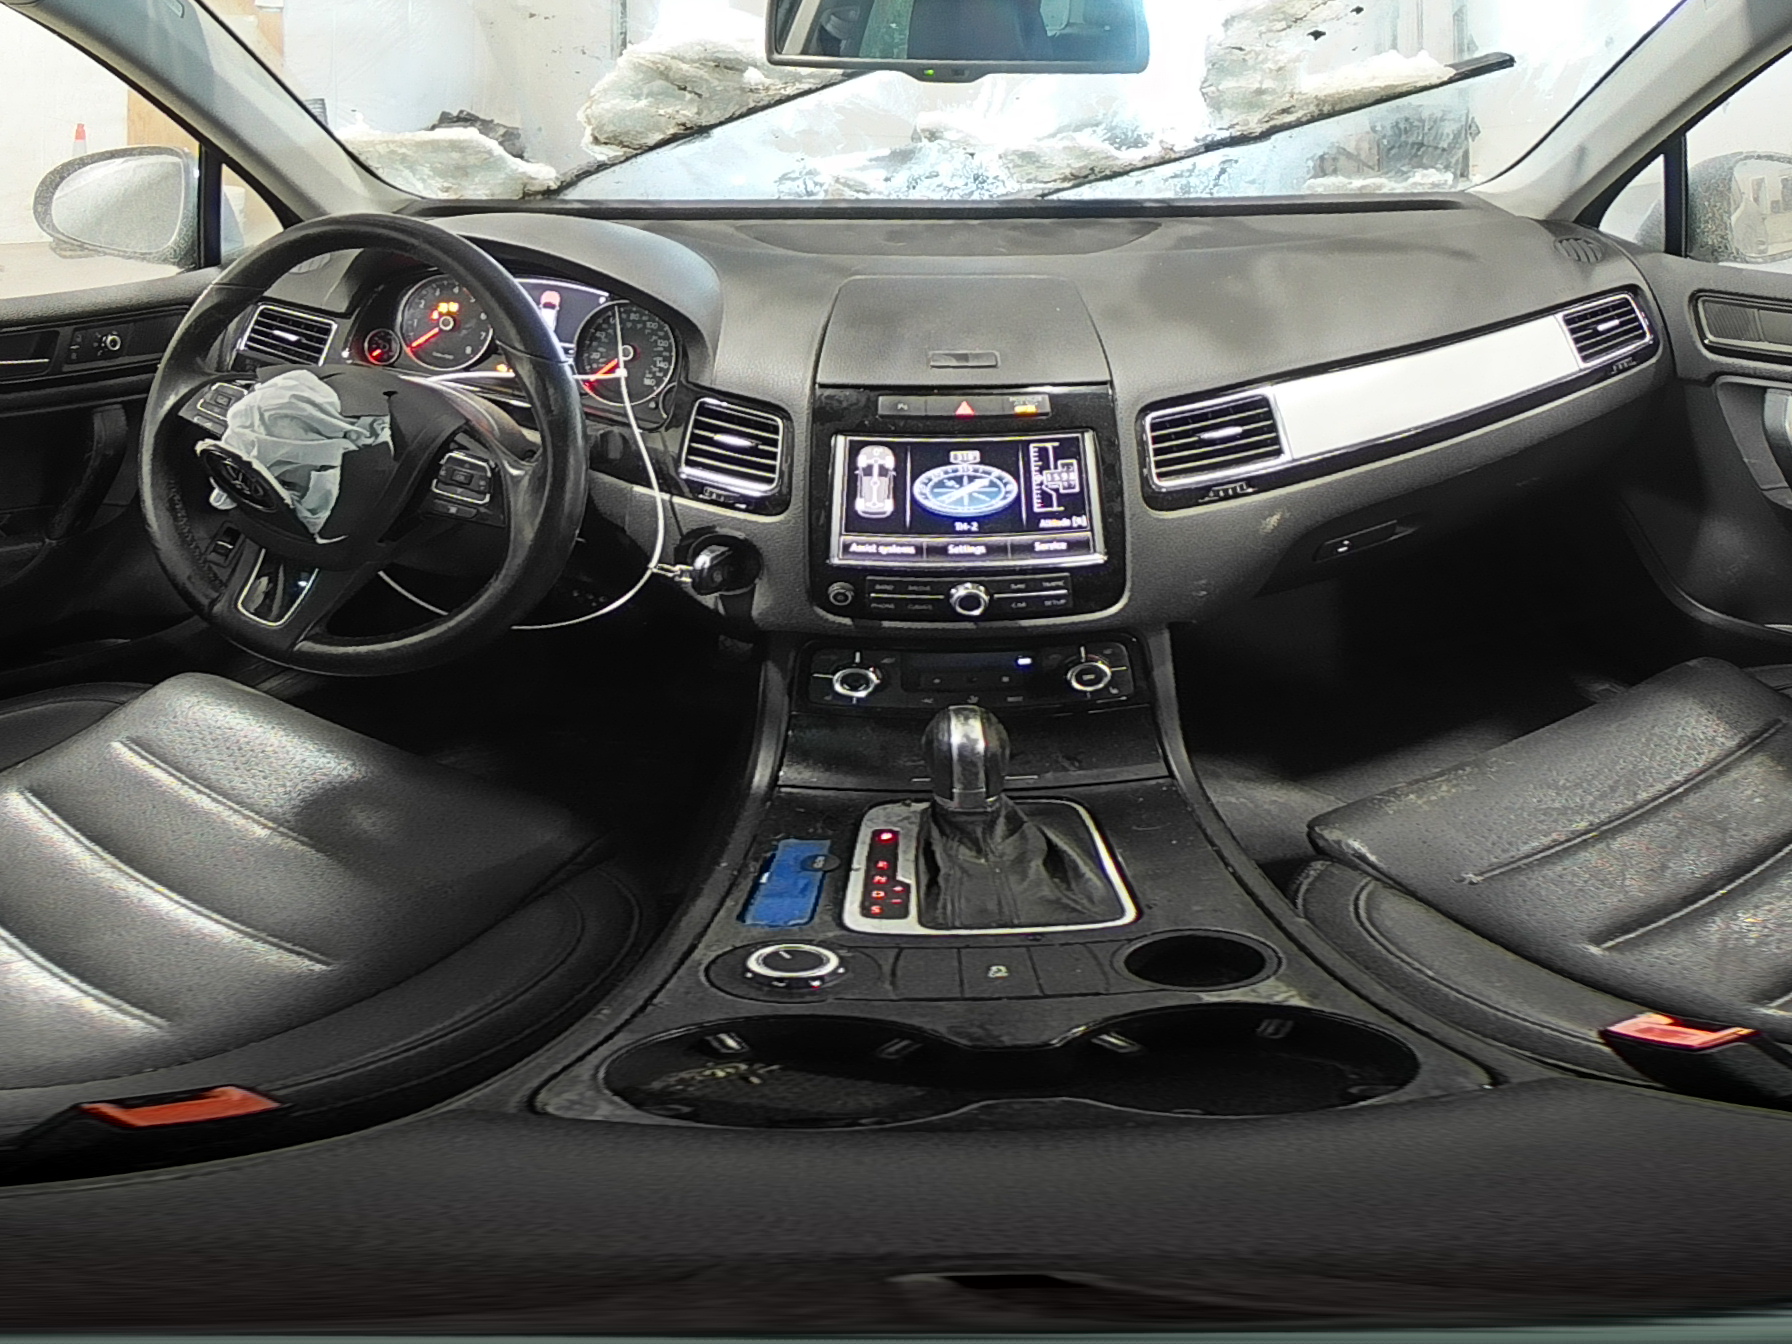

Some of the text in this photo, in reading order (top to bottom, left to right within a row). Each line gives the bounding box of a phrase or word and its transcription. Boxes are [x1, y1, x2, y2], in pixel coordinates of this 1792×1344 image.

[849, 542, 916, 556] Assist systems
[947, 543, 987, 557] Settings
[1034, 540, 1068, 552] Service
